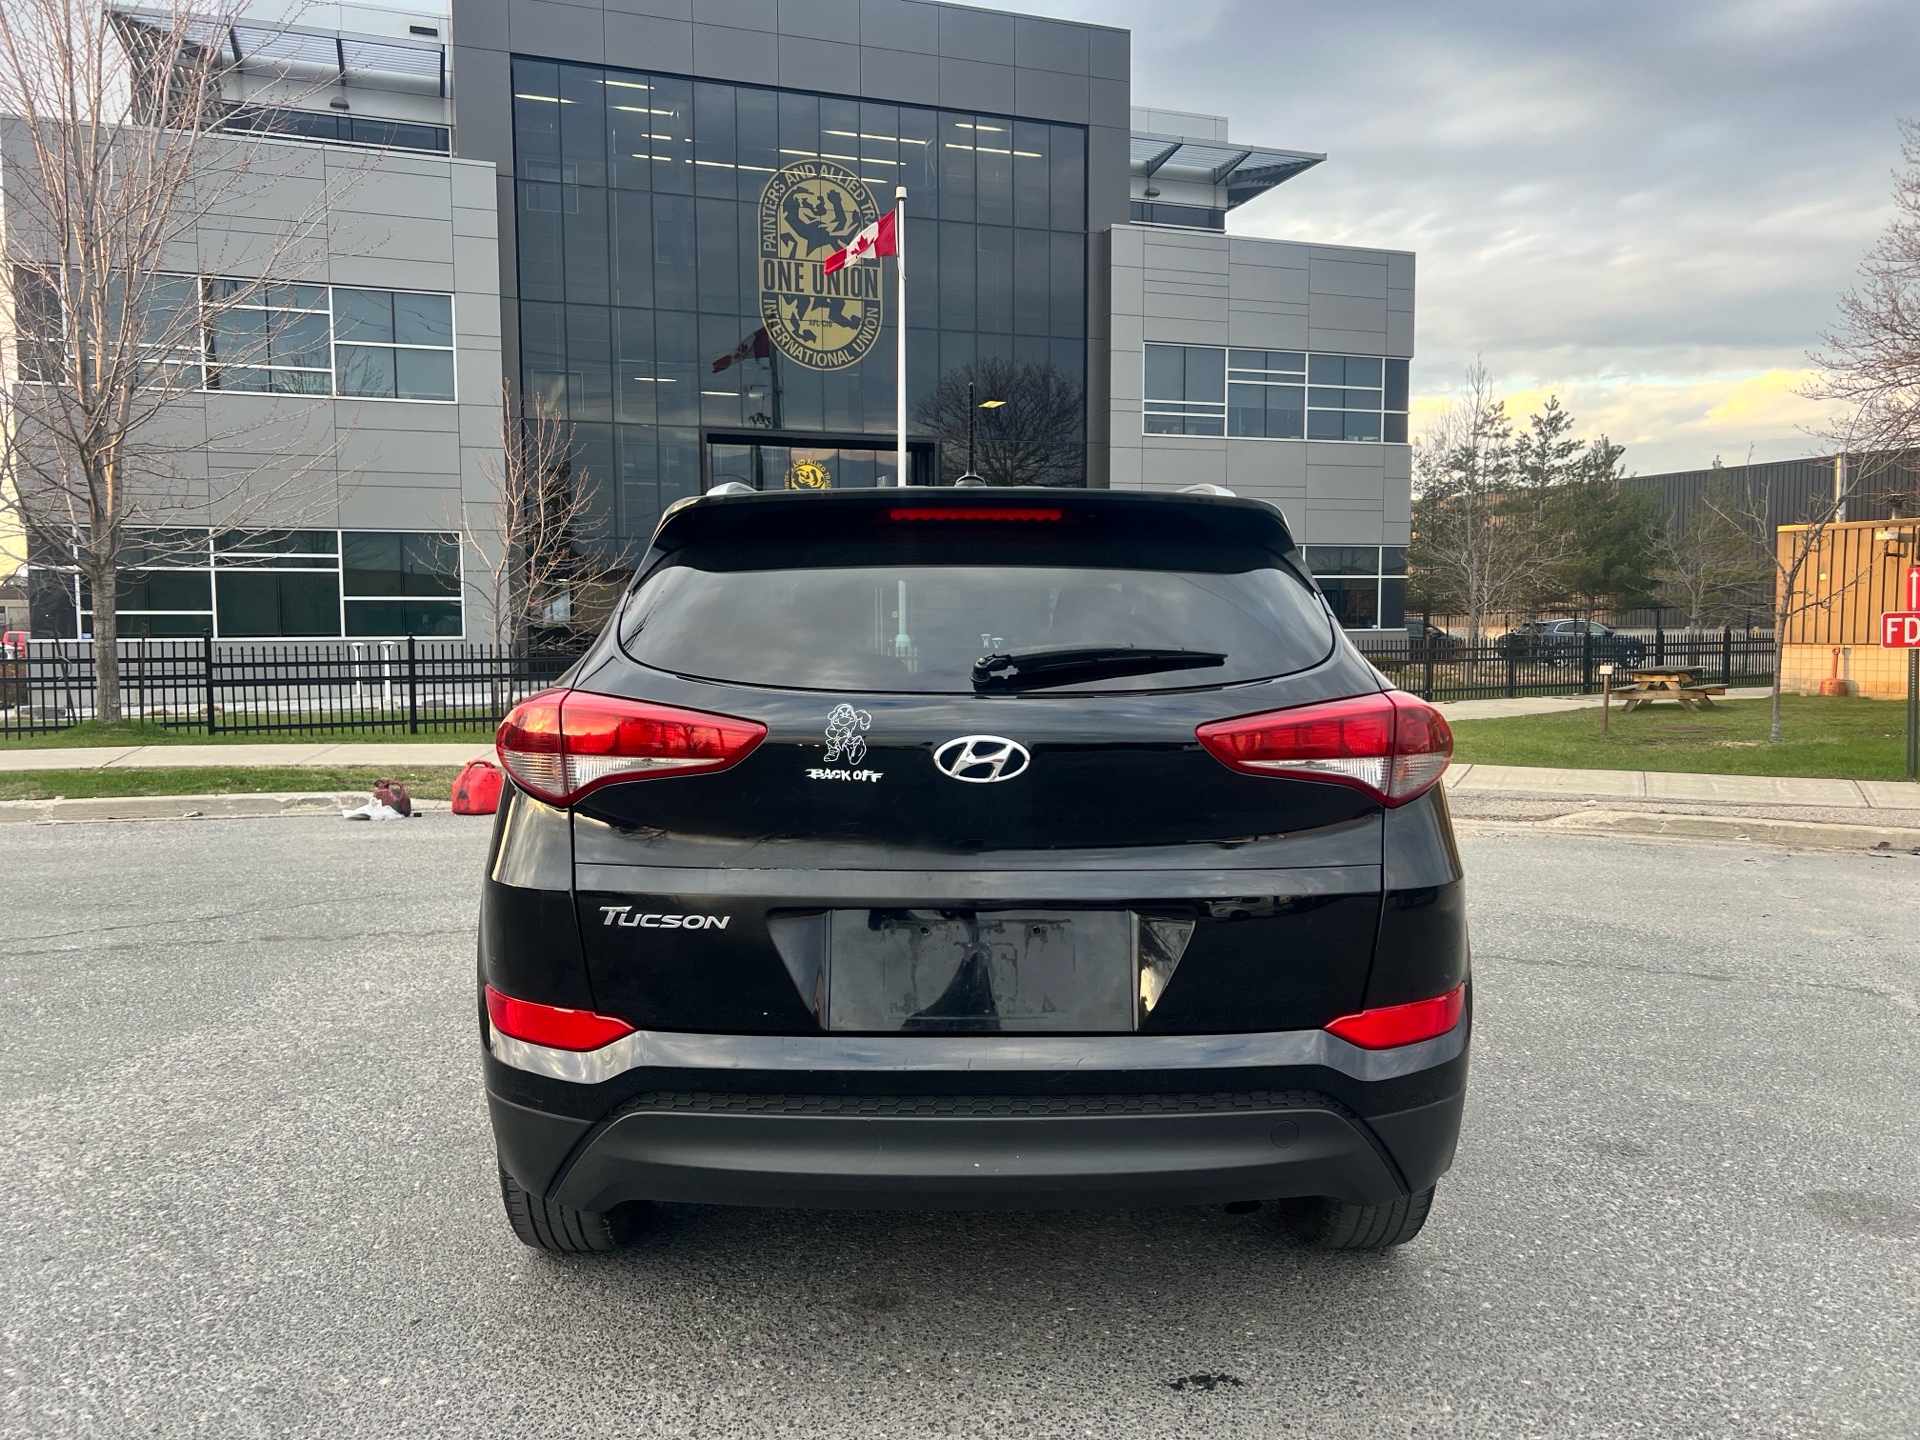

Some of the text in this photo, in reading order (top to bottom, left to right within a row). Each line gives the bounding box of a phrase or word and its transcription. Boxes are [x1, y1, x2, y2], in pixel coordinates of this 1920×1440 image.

[763, 165, 866, 252] PAINTERS AND ALLIED
[763, 260, 879, 299] ONE UNION
[763, 299, 879, 367] INTERNATIONAL UNION
[792, 459, 805, 469] AND
[806, 459, 826, 472] ALLIED
[824, 472, 832, 490] TRAD
[805, 768, 884, 783] BACK OFF
